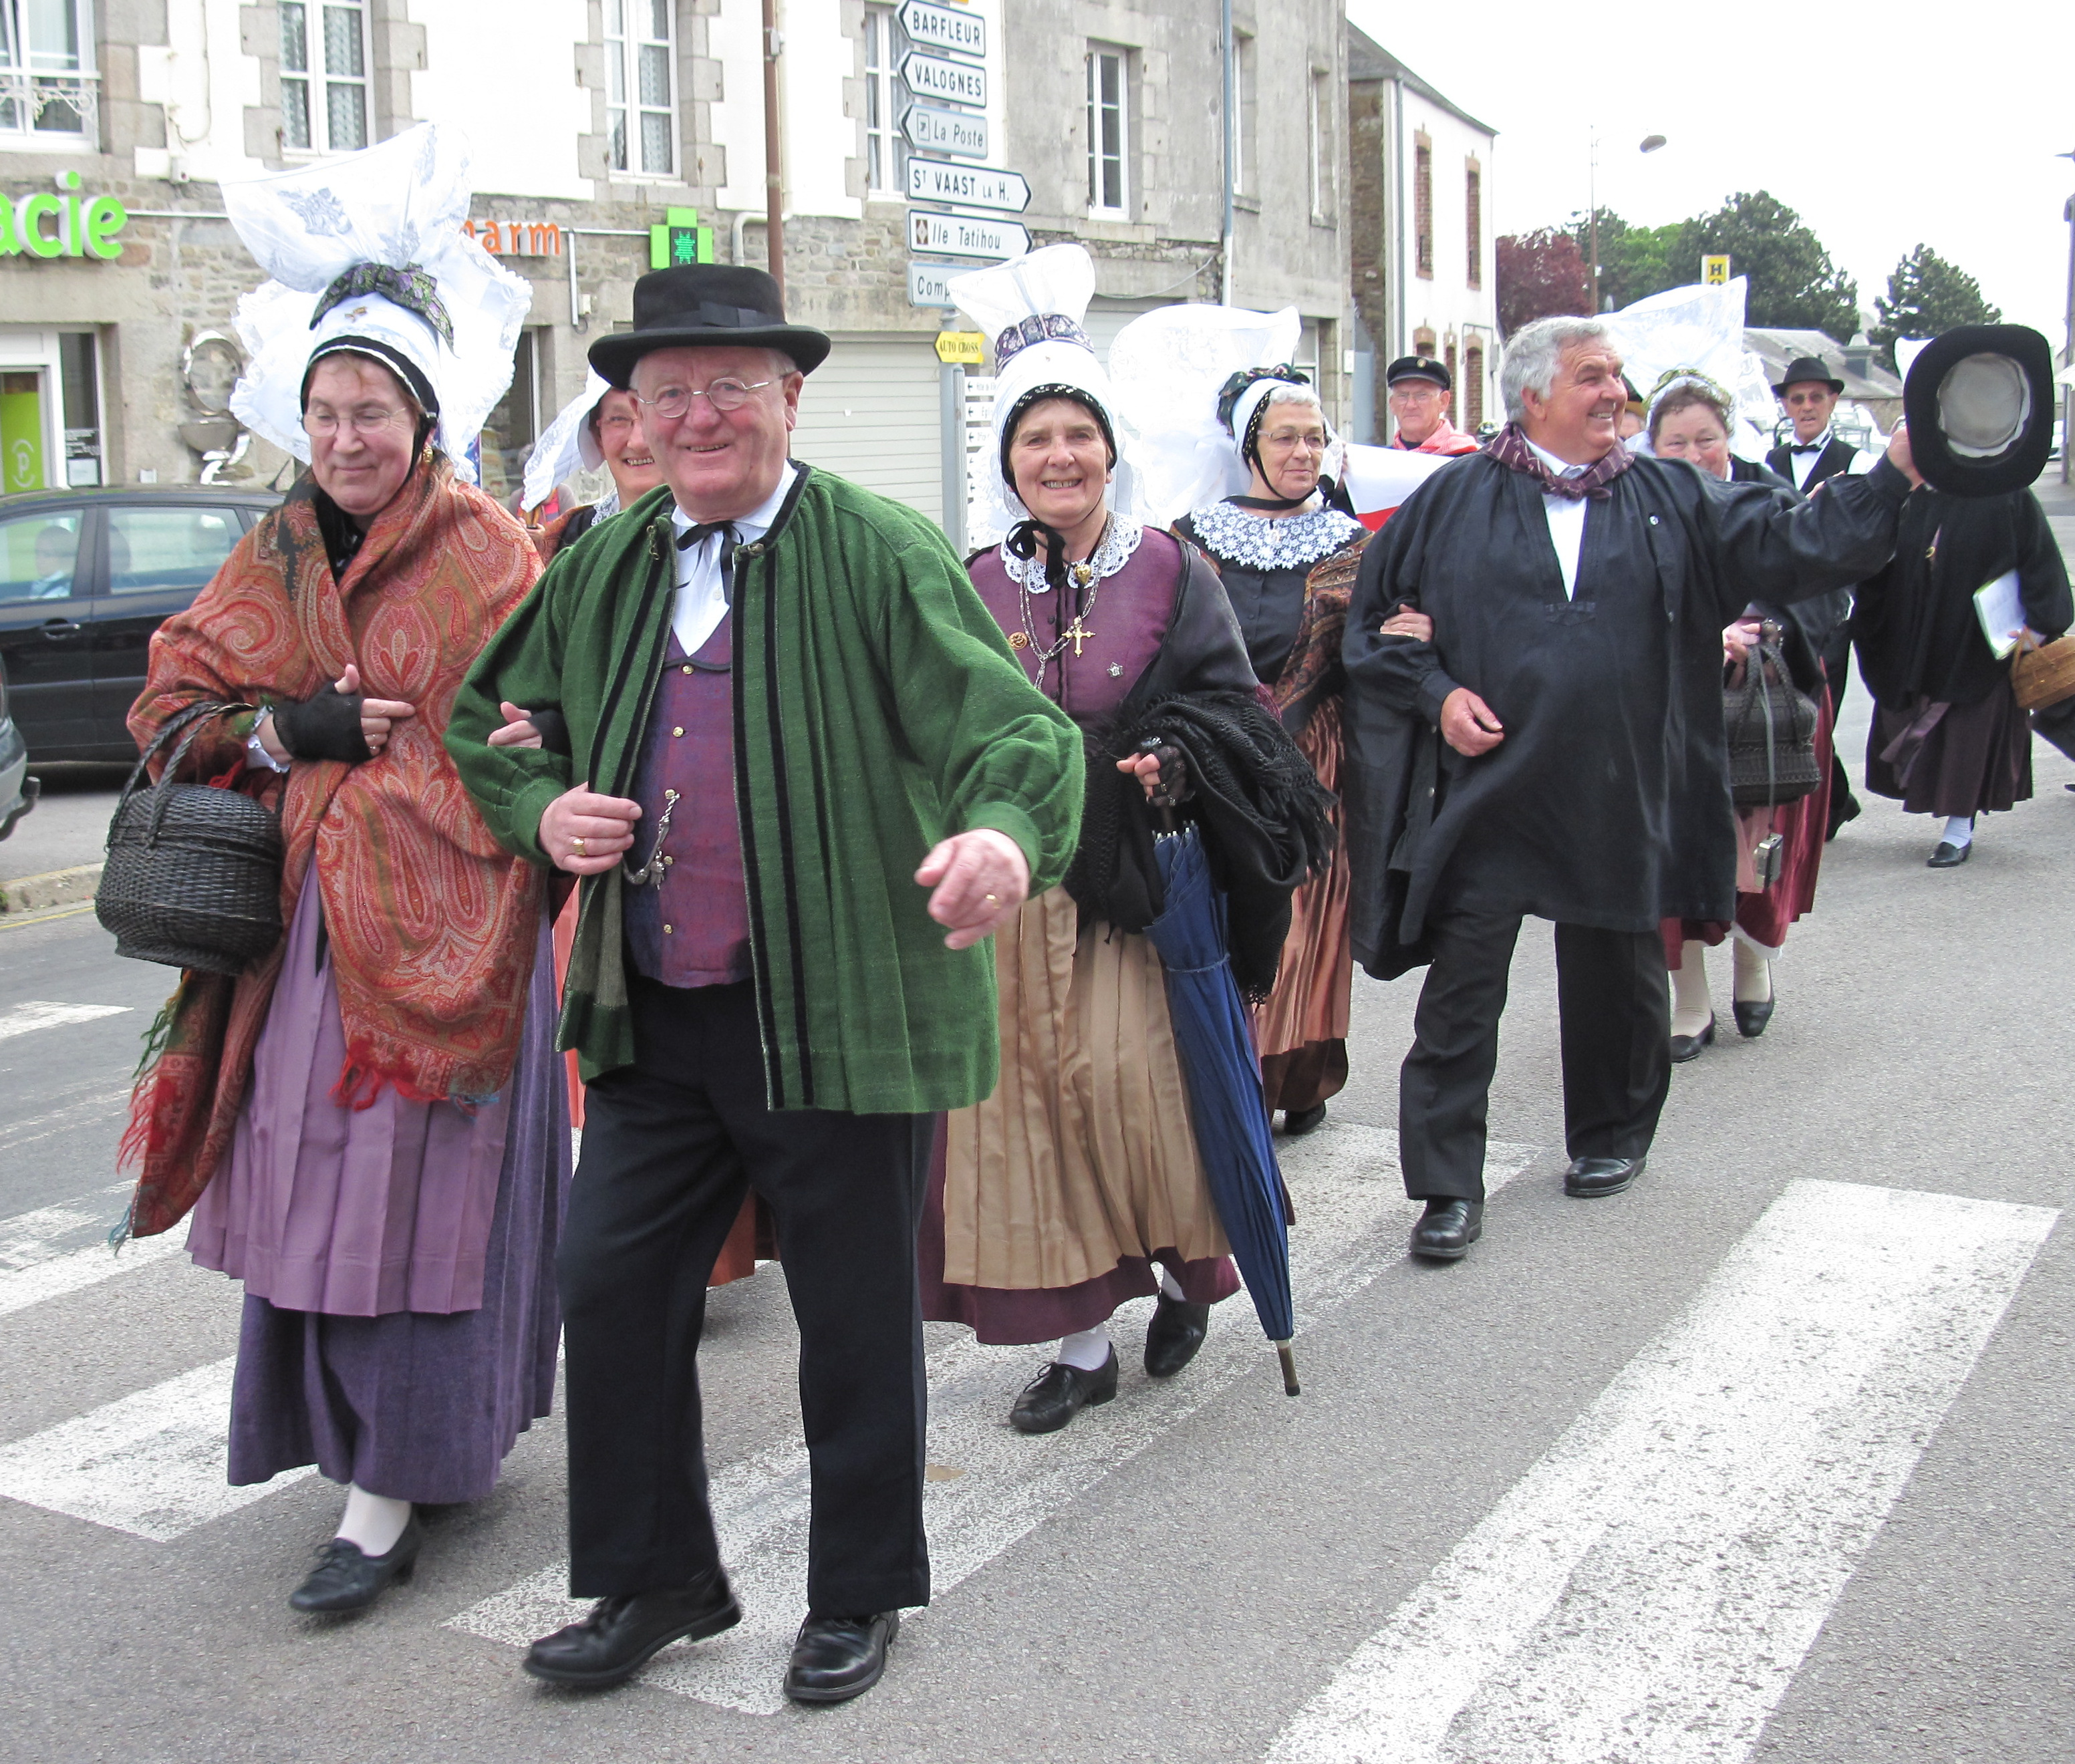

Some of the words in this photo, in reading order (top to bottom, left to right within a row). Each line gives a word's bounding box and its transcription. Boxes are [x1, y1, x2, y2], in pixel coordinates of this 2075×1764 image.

[913, 10, 980, 47] BARFLEUR
[915, 63, 982, 97] VALOGNES
[934, 120, 946, 140] La
[954, 124, 983, 147] Poste
[935, 171, 975, 196] VAAST
[983, 185, 992, 199] LA
[999, 181, 1010, 202] H.
[959, 227, 1001, 249] Tatihou
[940, 340, 956, 353] AUTO
[958, 341, 979, 353] CROSS
